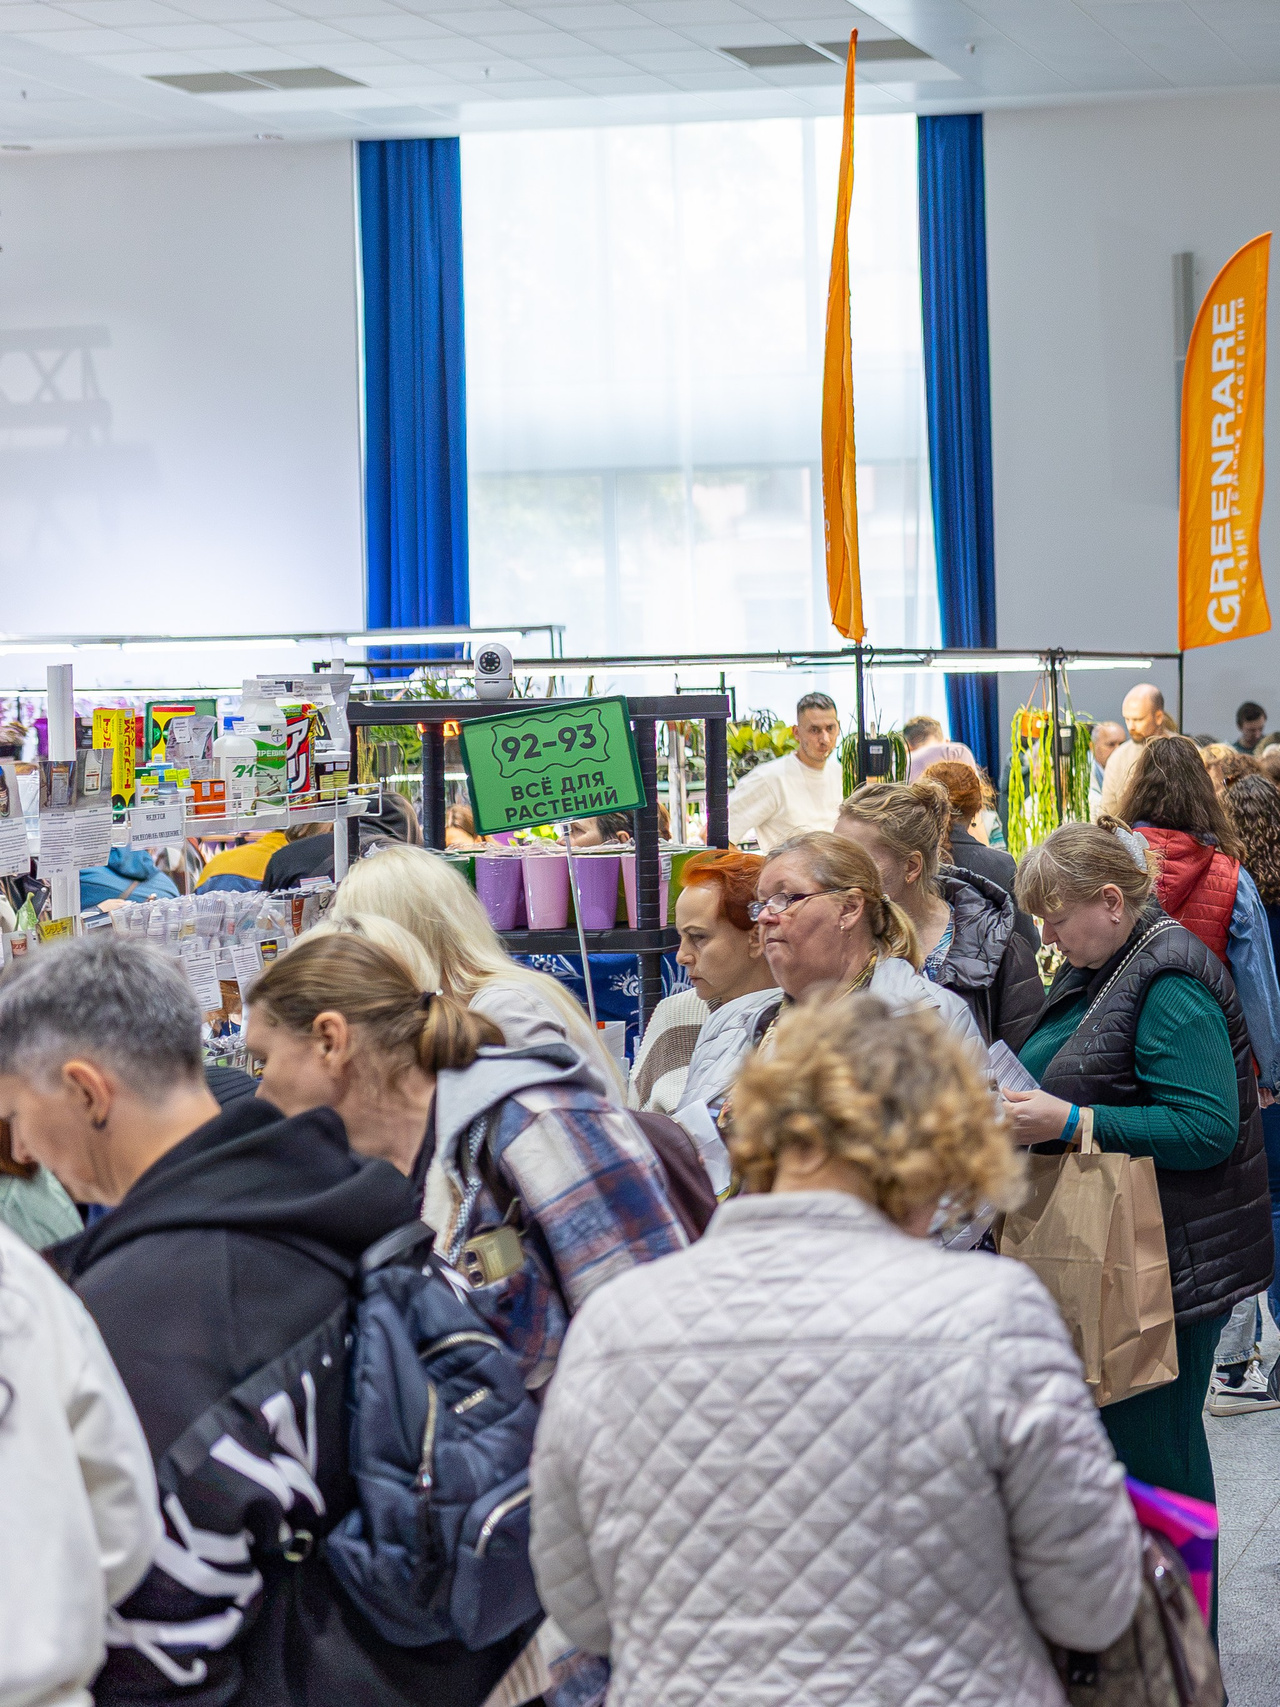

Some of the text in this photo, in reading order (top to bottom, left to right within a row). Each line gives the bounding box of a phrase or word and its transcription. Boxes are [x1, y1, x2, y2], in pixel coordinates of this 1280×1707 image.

[1206, 298, 1241, 634] GREENRARE
[501, 723, 597, 762] 92-93
[504, 786, 619, 823] РАСТЕНИЙ
[511, 771, 605, 802] ВСЁ ДЛЯ
